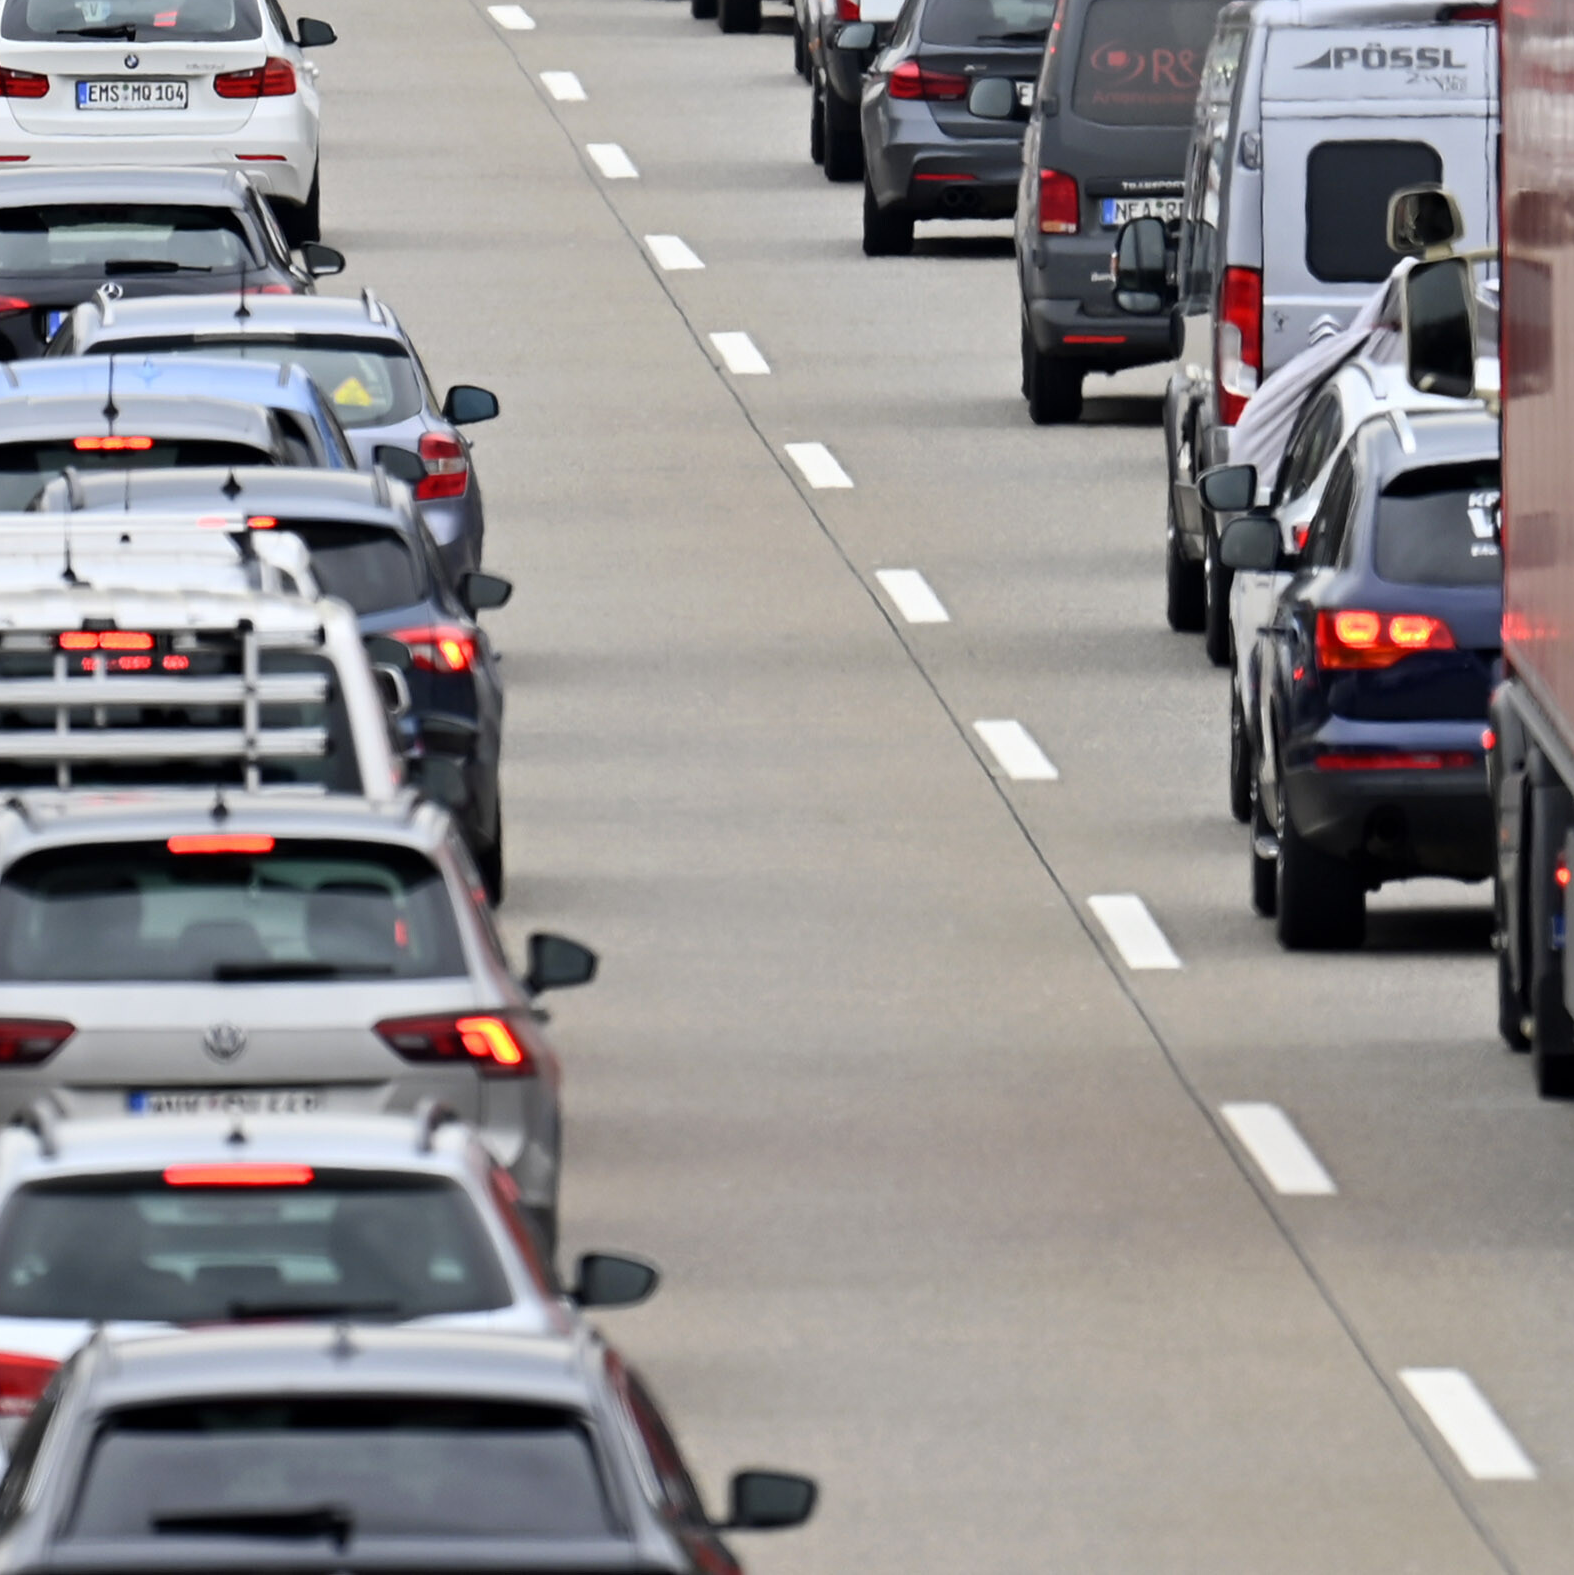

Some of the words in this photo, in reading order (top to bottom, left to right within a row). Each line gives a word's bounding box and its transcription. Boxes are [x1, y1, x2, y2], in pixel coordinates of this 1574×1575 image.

[1333, 42, 1467, 70] PÖSSL
[88, 85, 120, 102] EMS
[131, 85, 152, 103] MQ
[155, 84, 184, 102] 104
